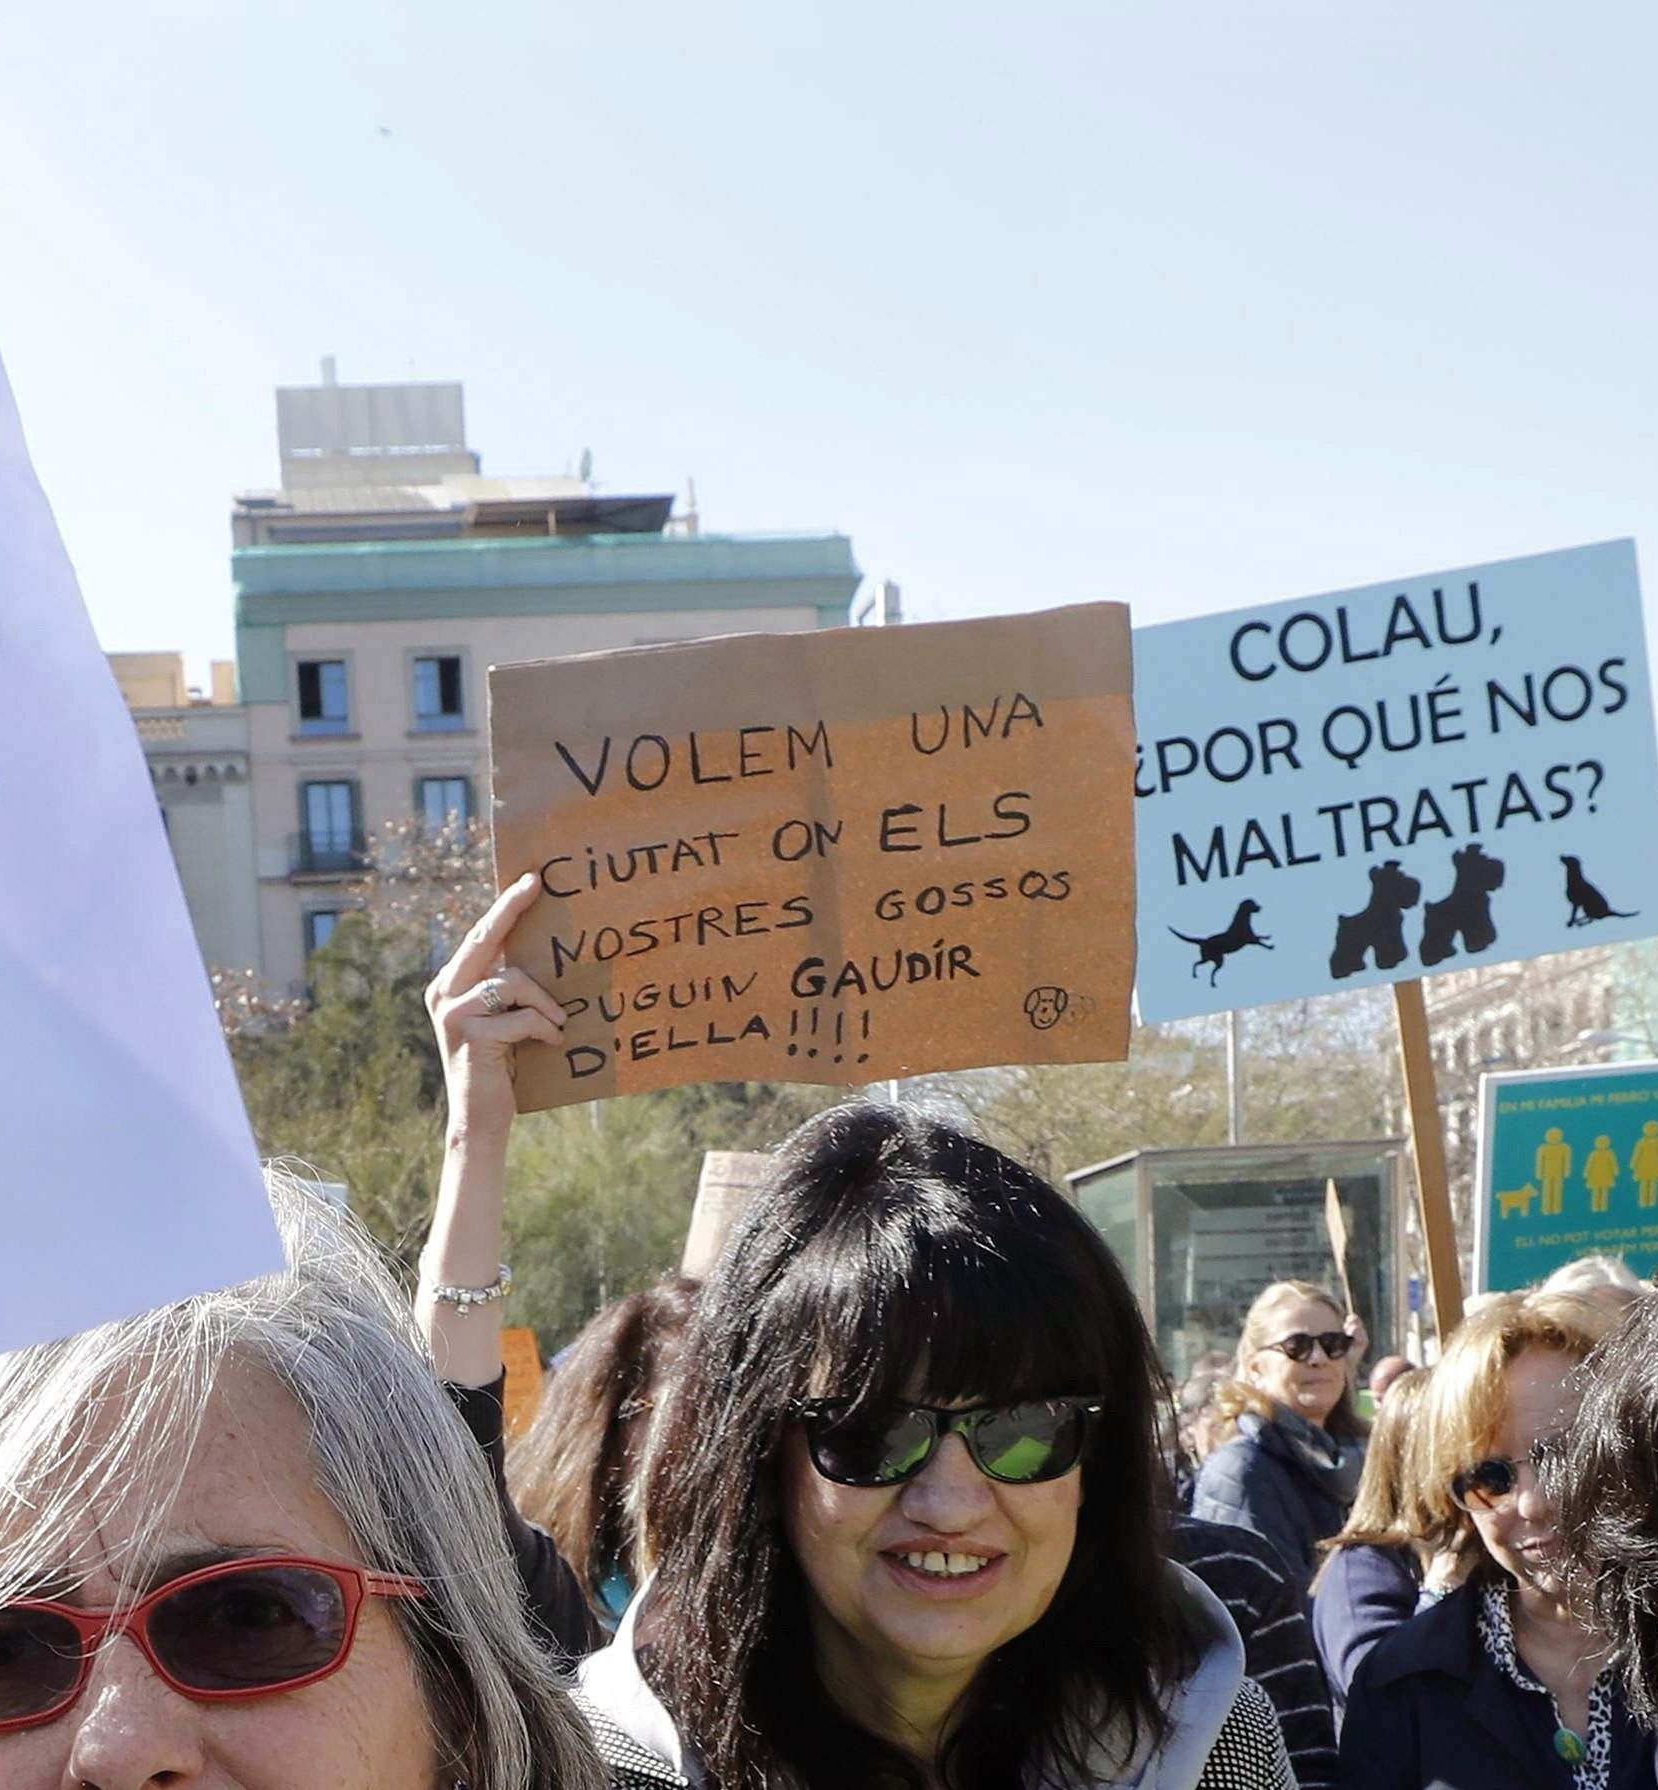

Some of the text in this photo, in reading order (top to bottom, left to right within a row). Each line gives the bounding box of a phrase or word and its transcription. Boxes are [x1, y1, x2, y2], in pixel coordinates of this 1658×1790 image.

[1230, 582, 1503, 681] COLAU,
[554, 693, 1044, 797] VOLEM UNA
[1134, 657, 1630, 798] ¿POR QUÉ NOS
[772, 820, 844, 861] ON
[880, 791, 1031, 852] ELS
[1171, 760, 1606, 886] MALTRATAS?
[550, 870, 1071, 978] NOSTRES GOSSOS
